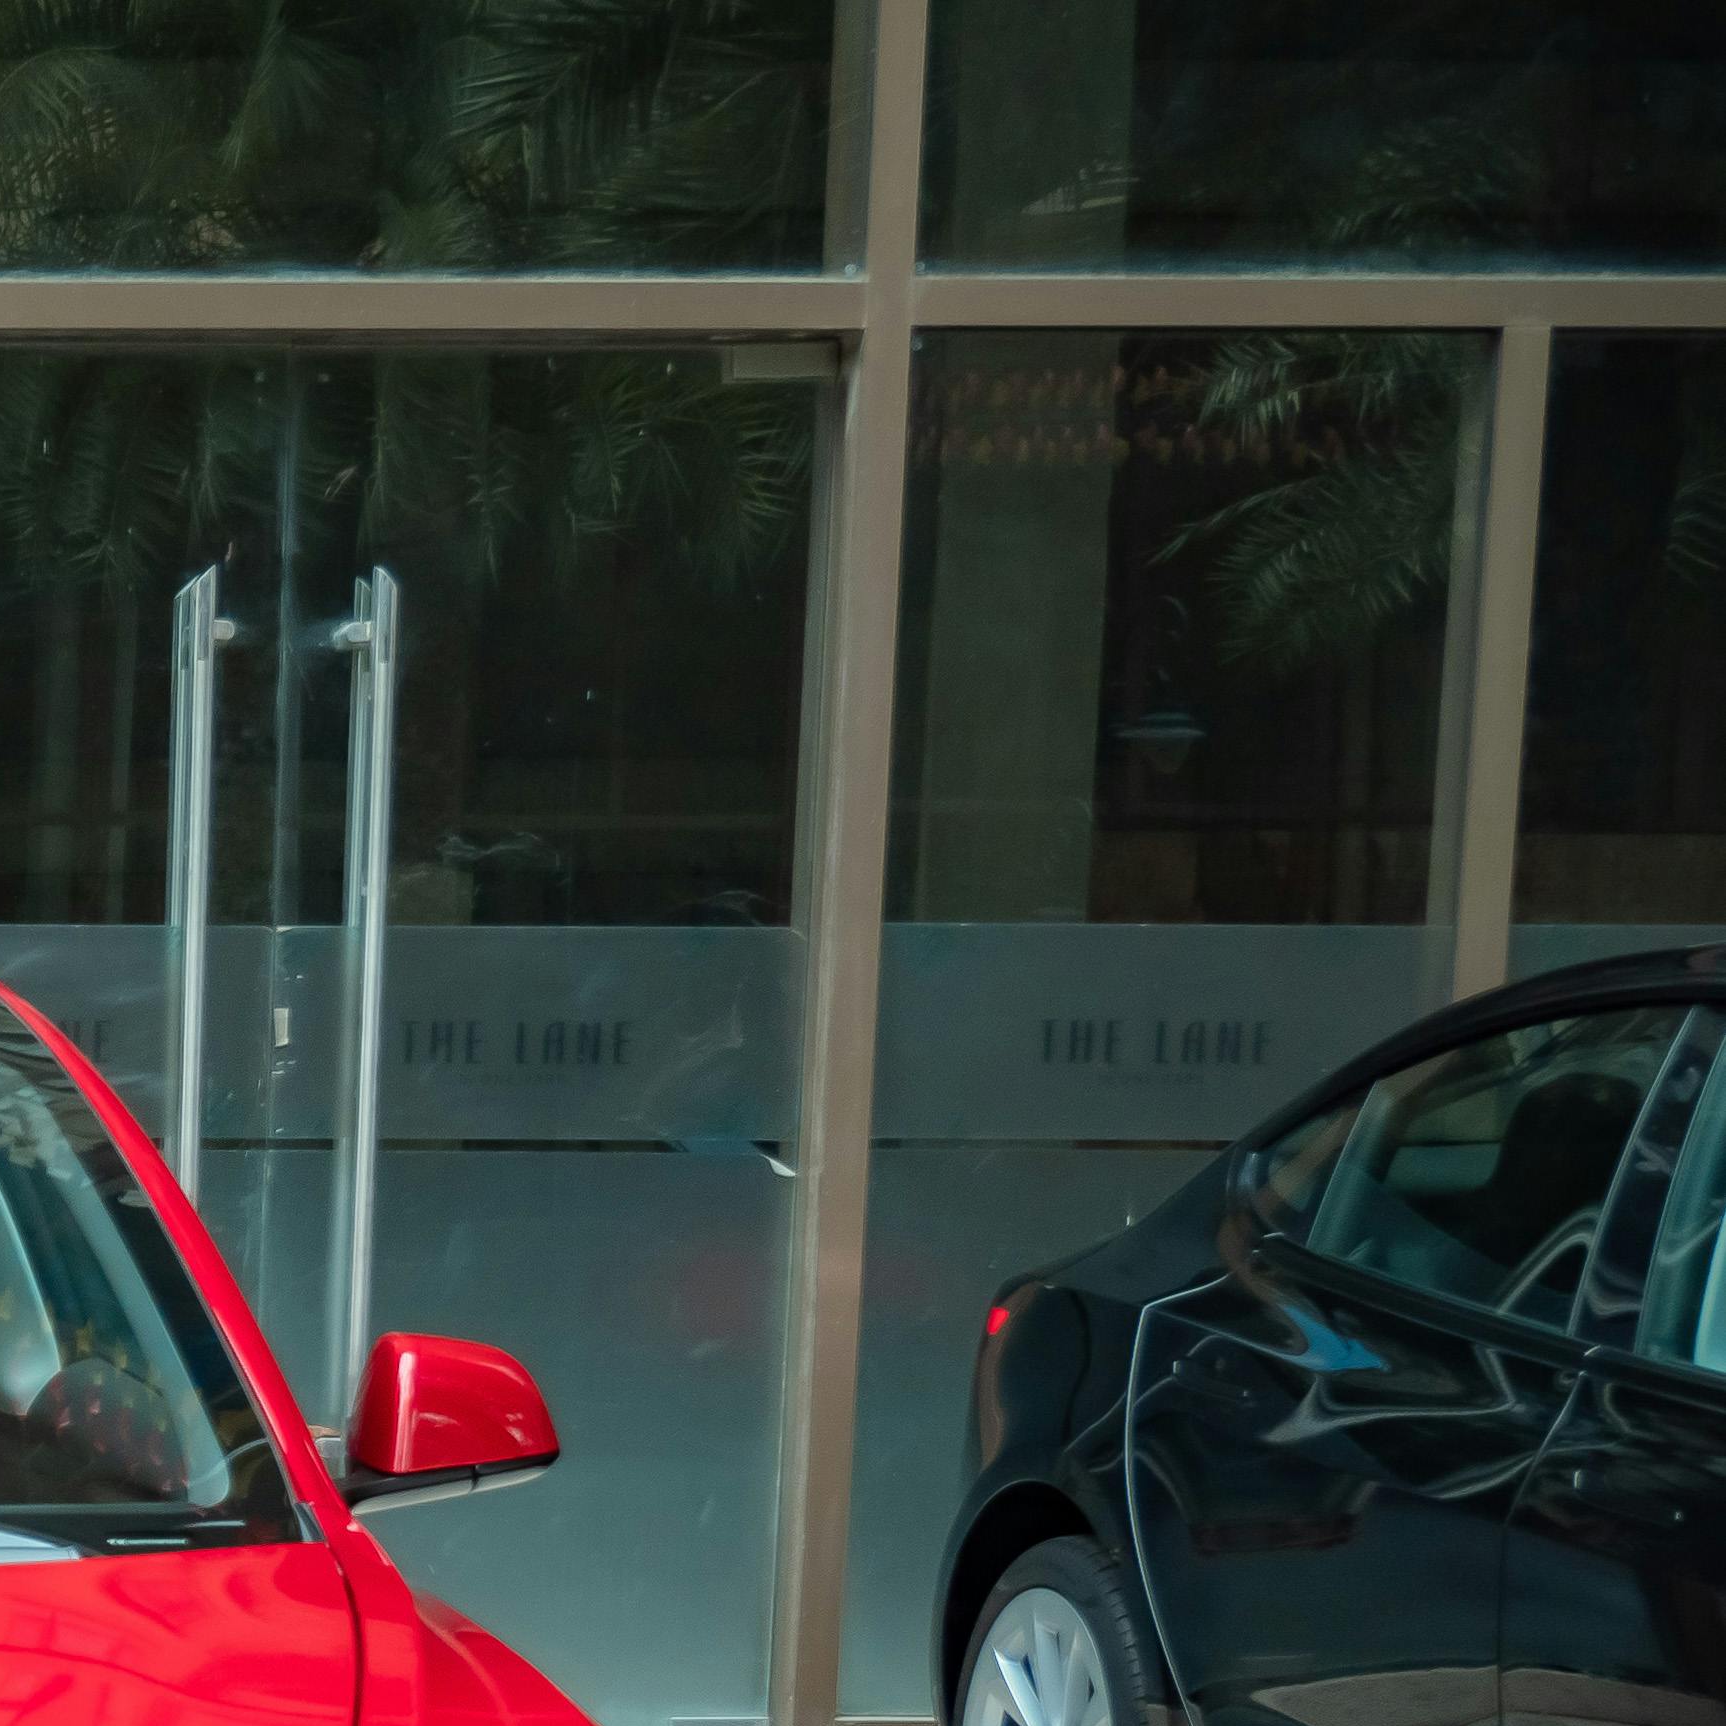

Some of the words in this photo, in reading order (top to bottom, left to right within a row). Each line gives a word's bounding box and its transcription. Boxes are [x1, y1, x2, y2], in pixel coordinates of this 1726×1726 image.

[402, 1020, 482, 1064] THE
[515, 1020, 632, 1064] LANE
[1042, 1019, 1123, 1063] THE
[1155, 1019, 1272, 1063] LANE
